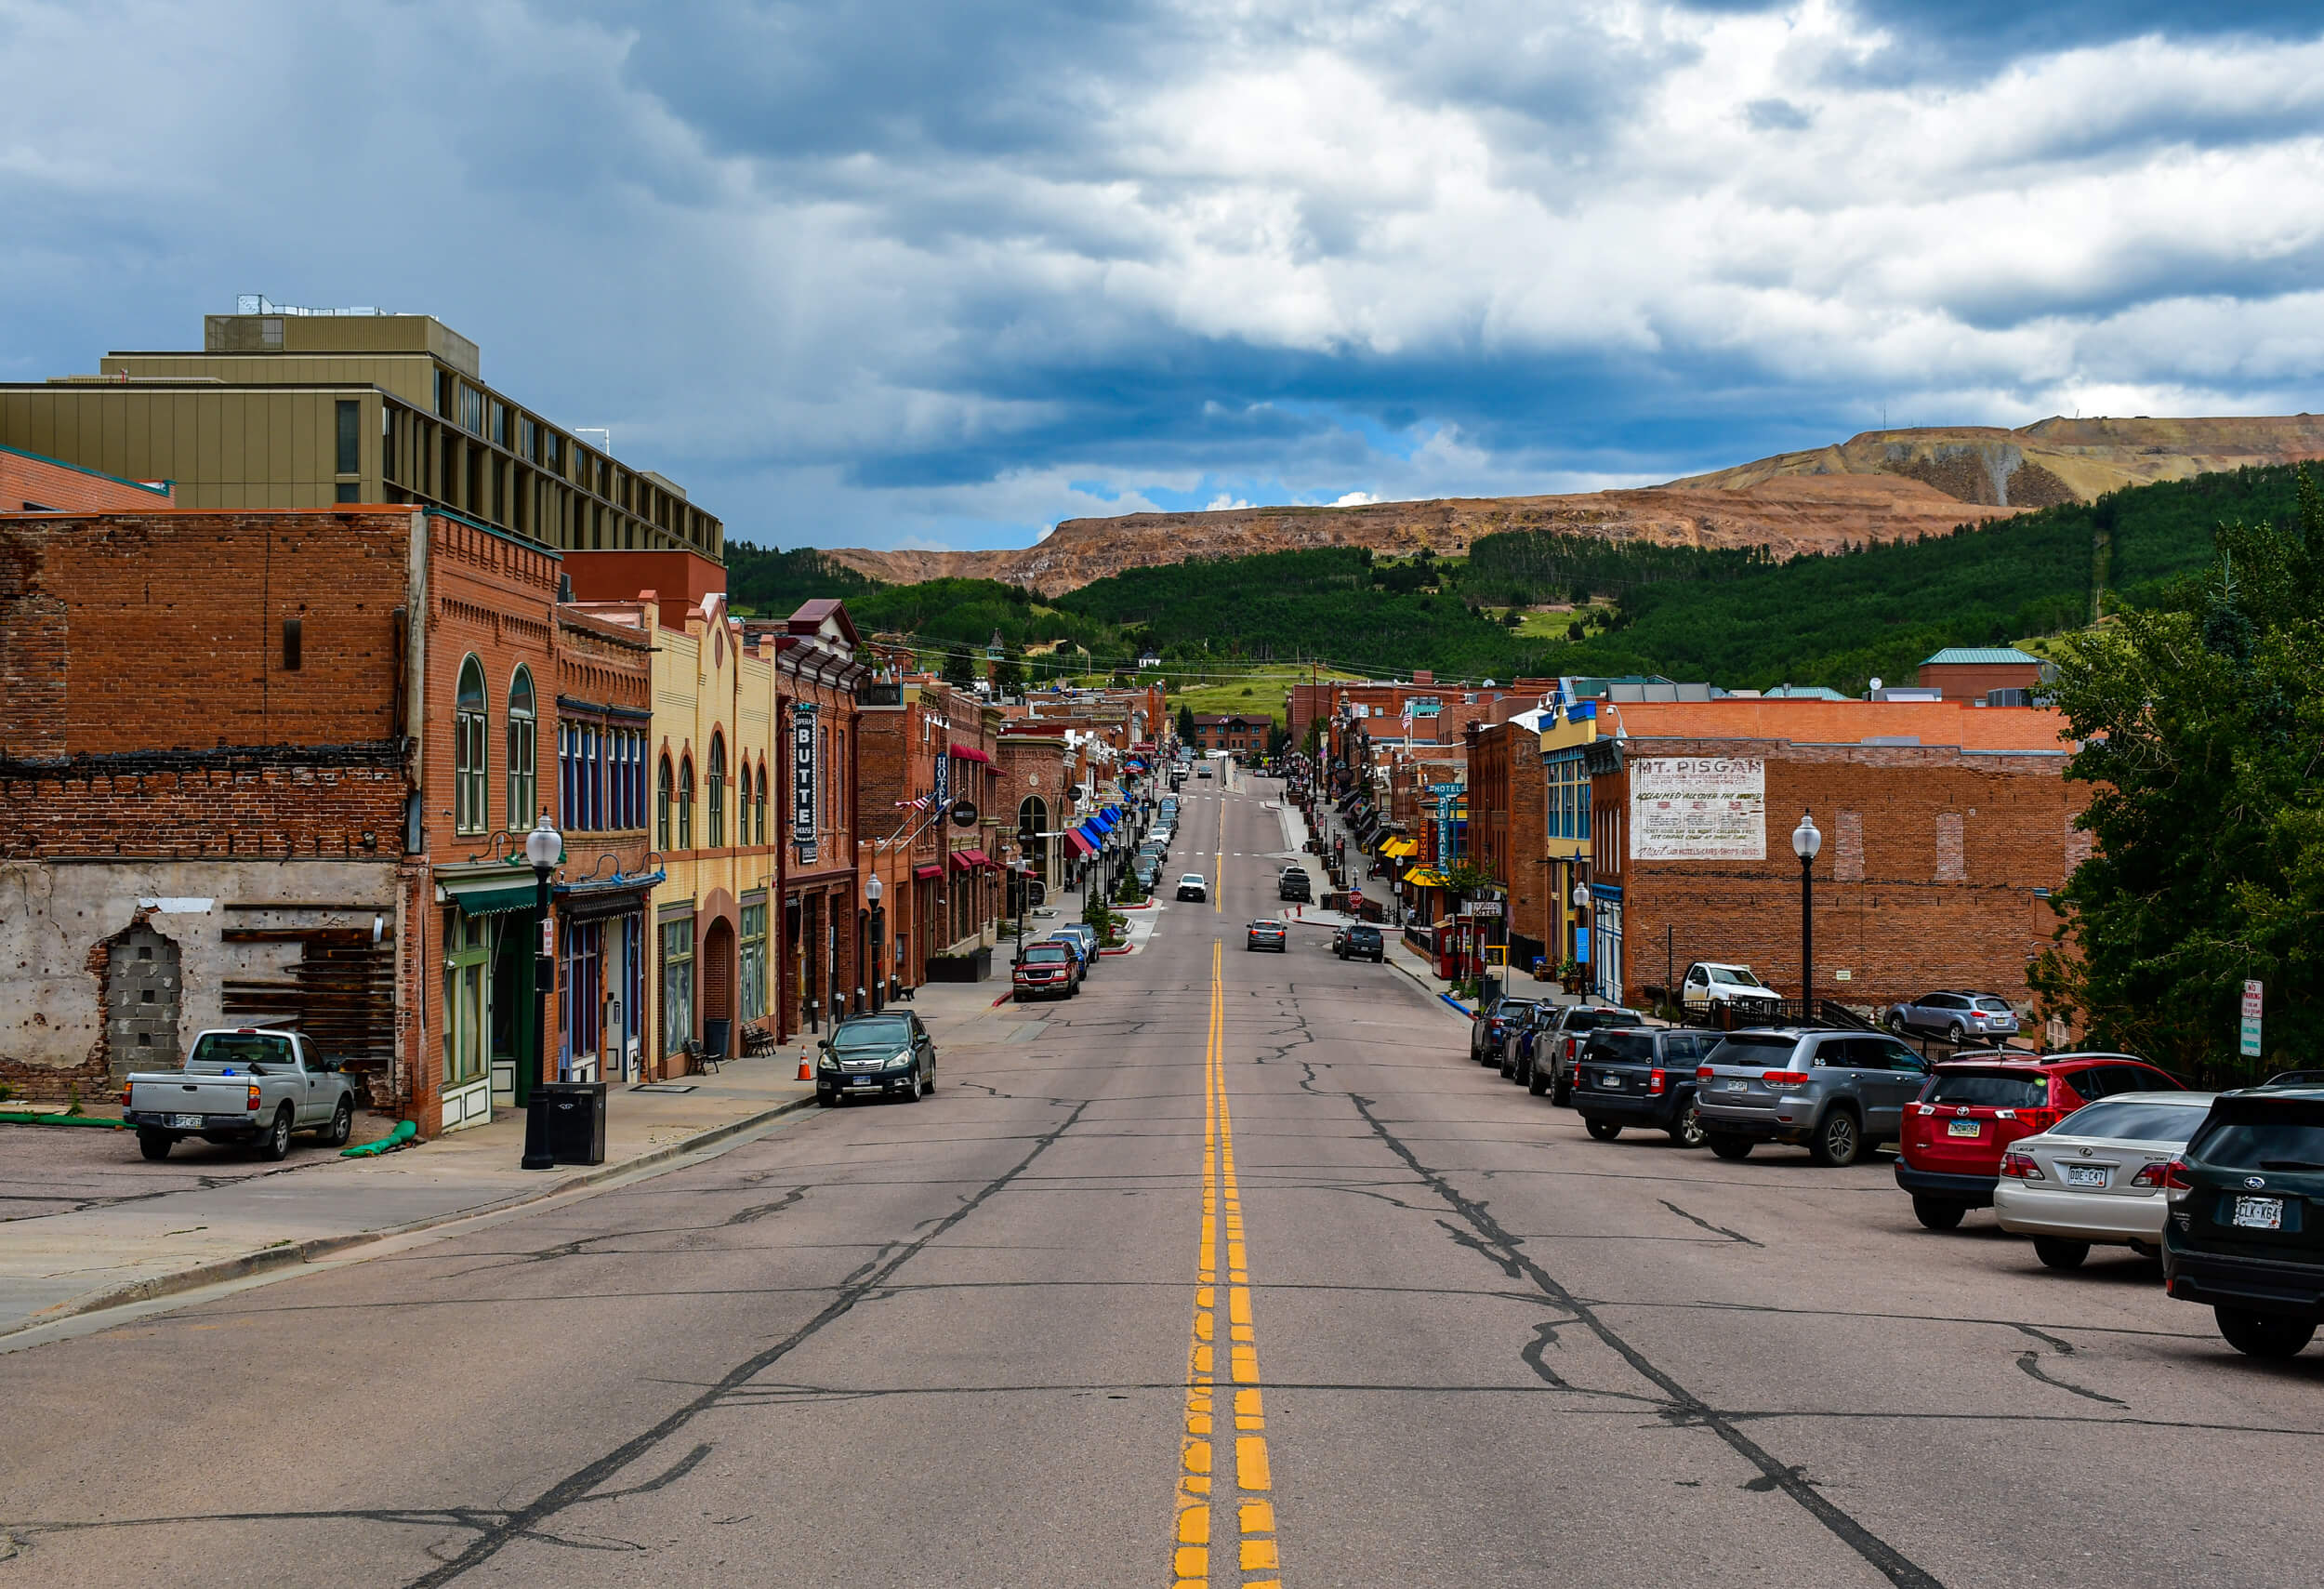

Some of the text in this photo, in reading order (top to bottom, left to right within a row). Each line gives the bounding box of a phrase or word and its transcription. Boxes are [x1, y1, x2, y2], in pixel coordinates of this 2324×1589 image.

[1639, 759, 1763, 775] MT. PISGAH
[798, 728, 811, 824] BUTTE
[1636, 791, 1681, 801] ACCLAIMED
